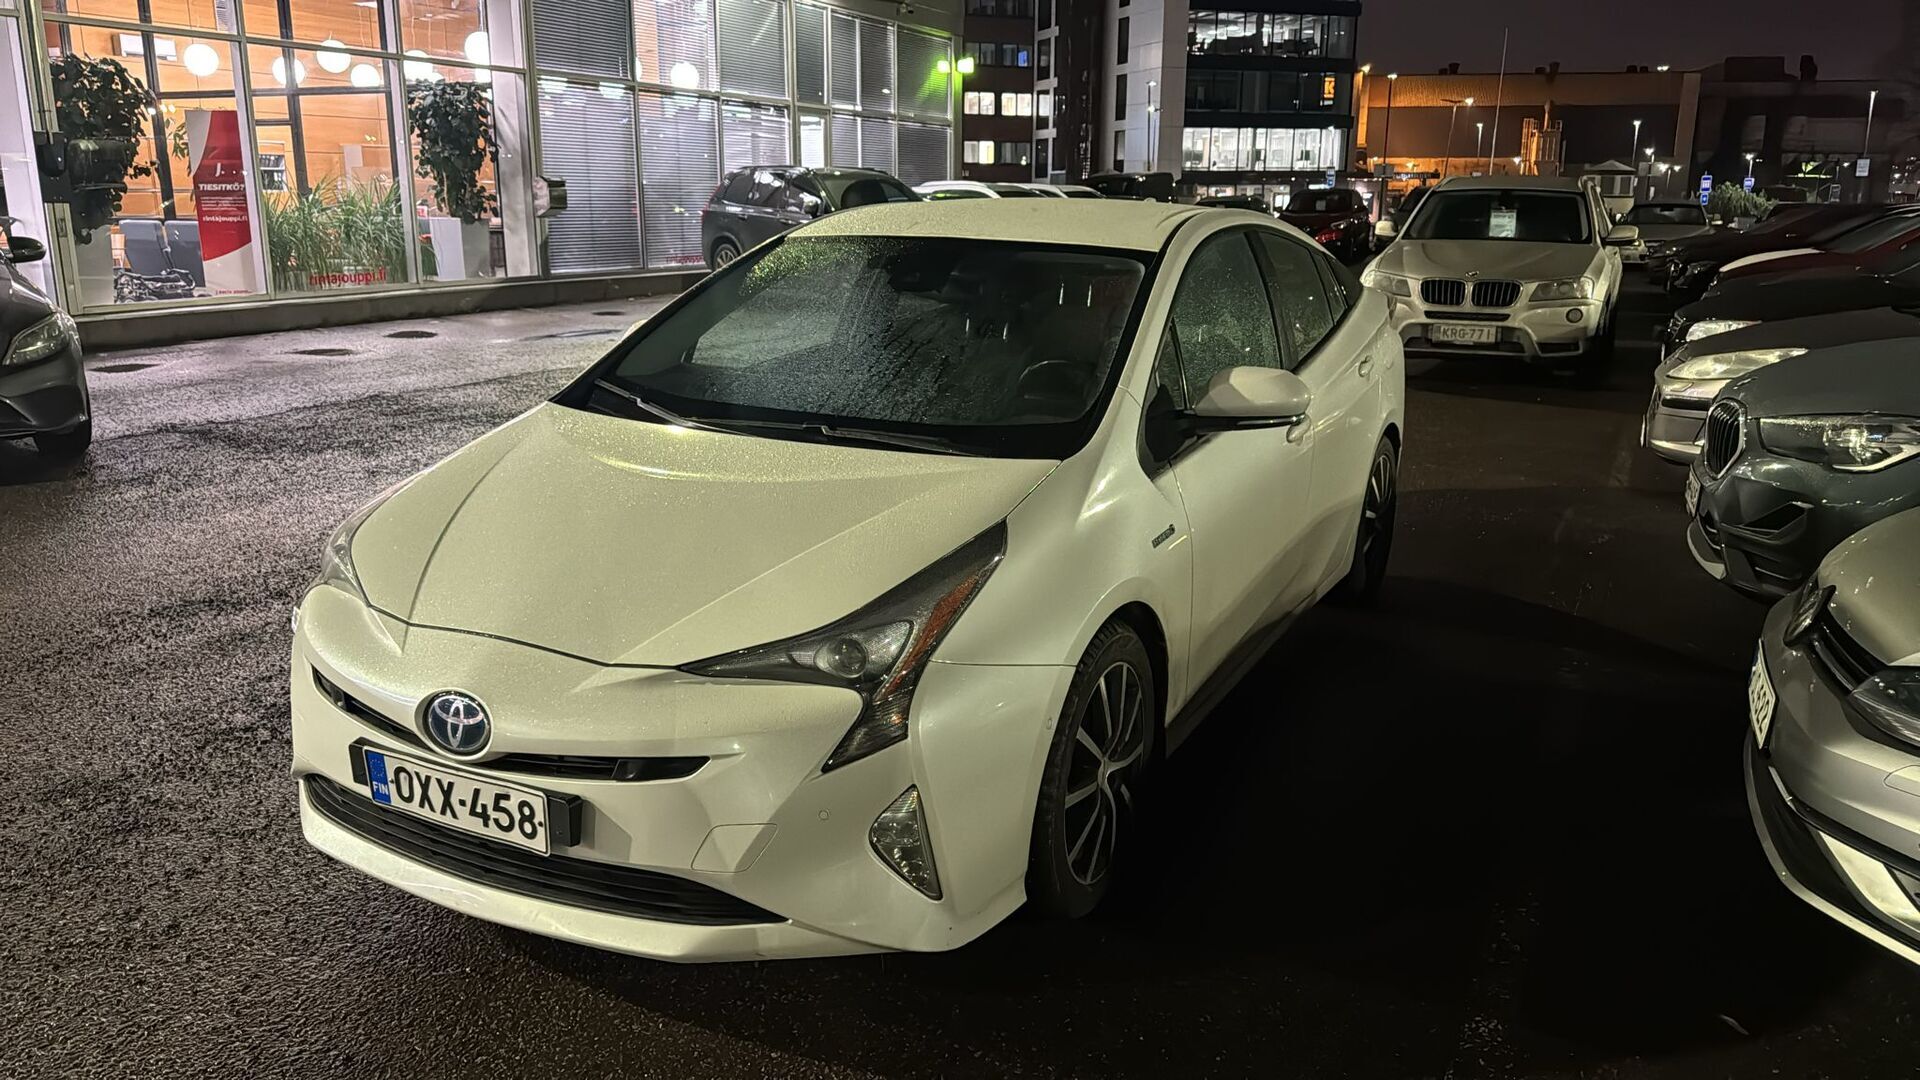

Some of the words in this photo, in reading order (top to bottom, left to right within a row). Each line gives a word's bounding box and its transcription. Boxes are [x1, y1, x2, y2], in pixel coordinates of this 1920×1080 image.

[198, 182, 245, 191] TIESITKÖ?
[373, 781, 389, 796] FIN
[393, 765, 539, 840] OXX-458
